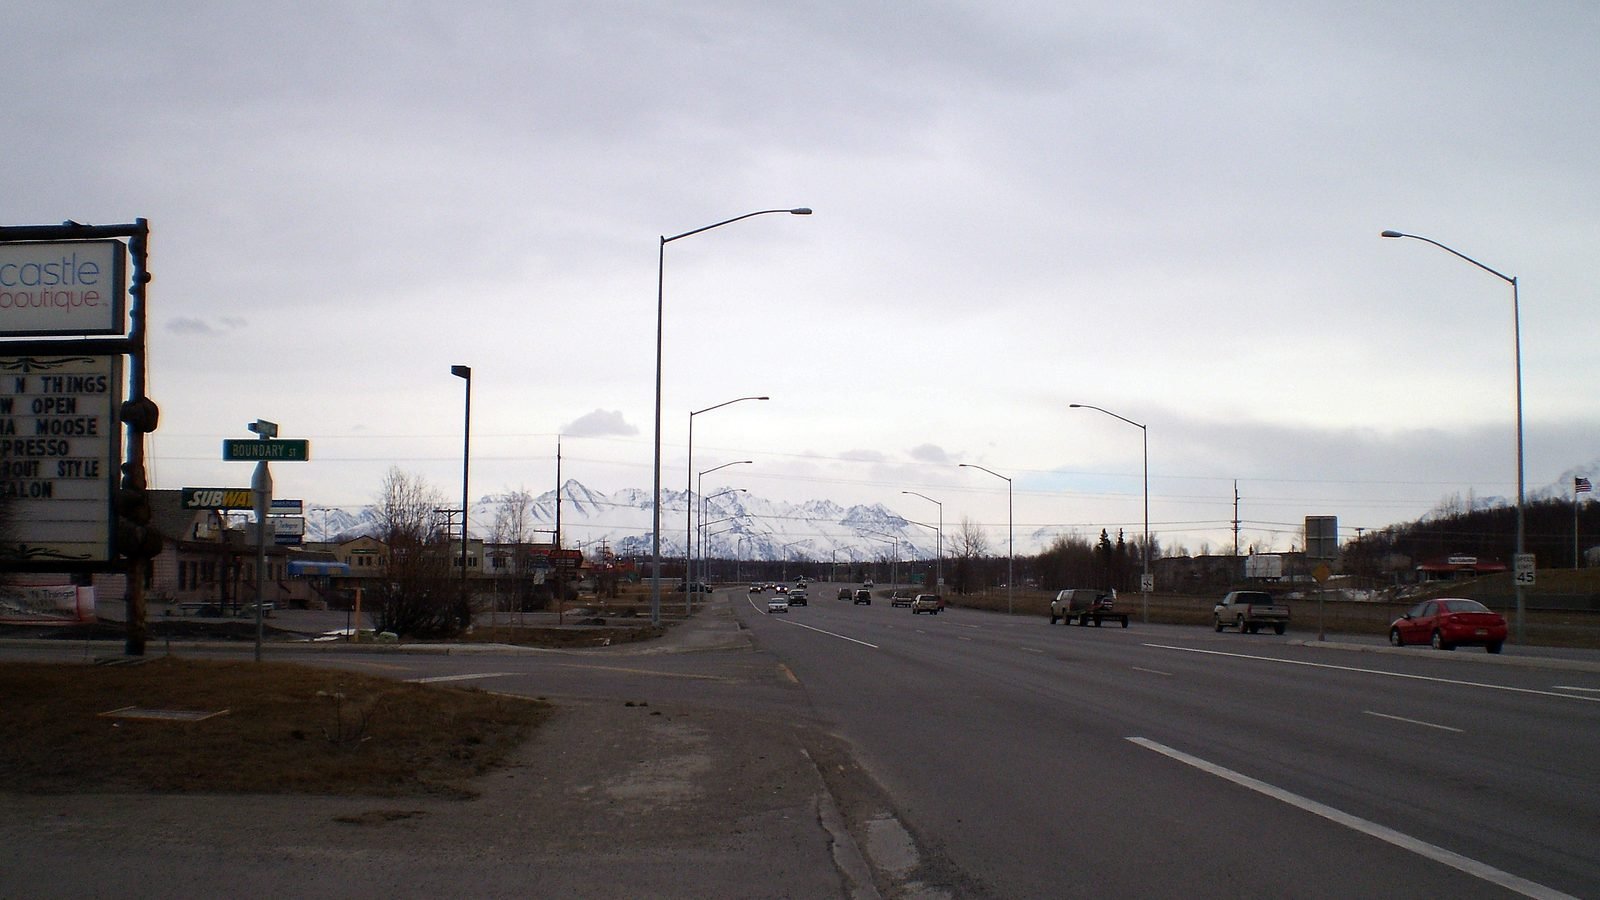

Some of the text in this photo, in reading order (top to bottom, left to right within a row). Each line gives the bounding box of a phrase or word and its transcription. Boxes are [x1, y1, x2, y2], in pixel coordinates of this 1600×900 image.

[0, 252, 100, 287] castle
[15, 376, 107, 393] N THINGS
[32, 398, 76, 414] OPEN
[36, 418, 97, 435] MOOSE
[3, 439, 69, 457] PRESSO
[232, 444, 297, 457] BOUNDARY ST
[58, 461, 99, 477] STYLE
[188, 491, 257, 507] SUBWA
[1517, 572, 1534, 582] 45
